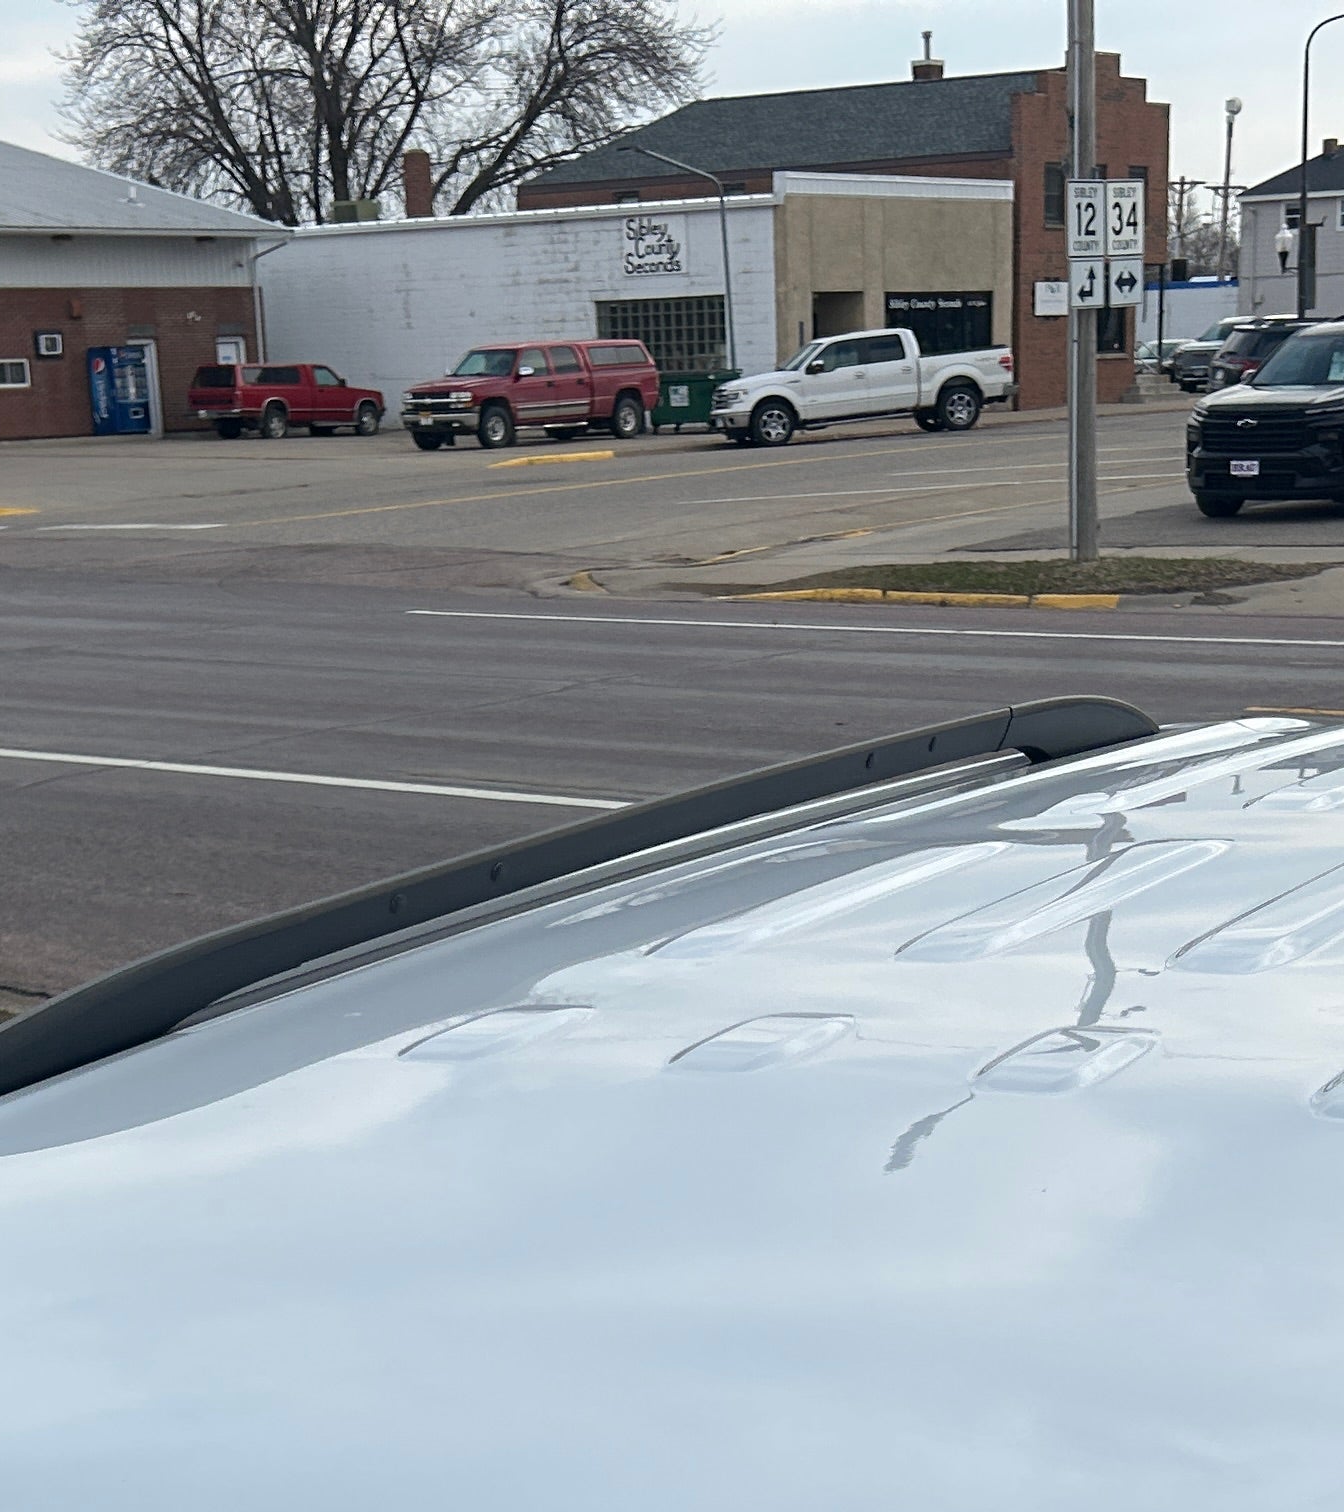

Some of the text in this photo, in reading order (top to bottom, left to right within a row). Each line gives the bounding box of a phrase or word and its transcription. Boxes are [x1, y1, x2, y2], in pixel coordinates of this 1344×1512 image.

[625, 217, 668, 243] Sibley
[1076, 202, 1096, 237] 12
[1112, 201, 1138, 236] 34
[635, 234, 681, 260] County
[624, 252, 681, 274] Seconds
